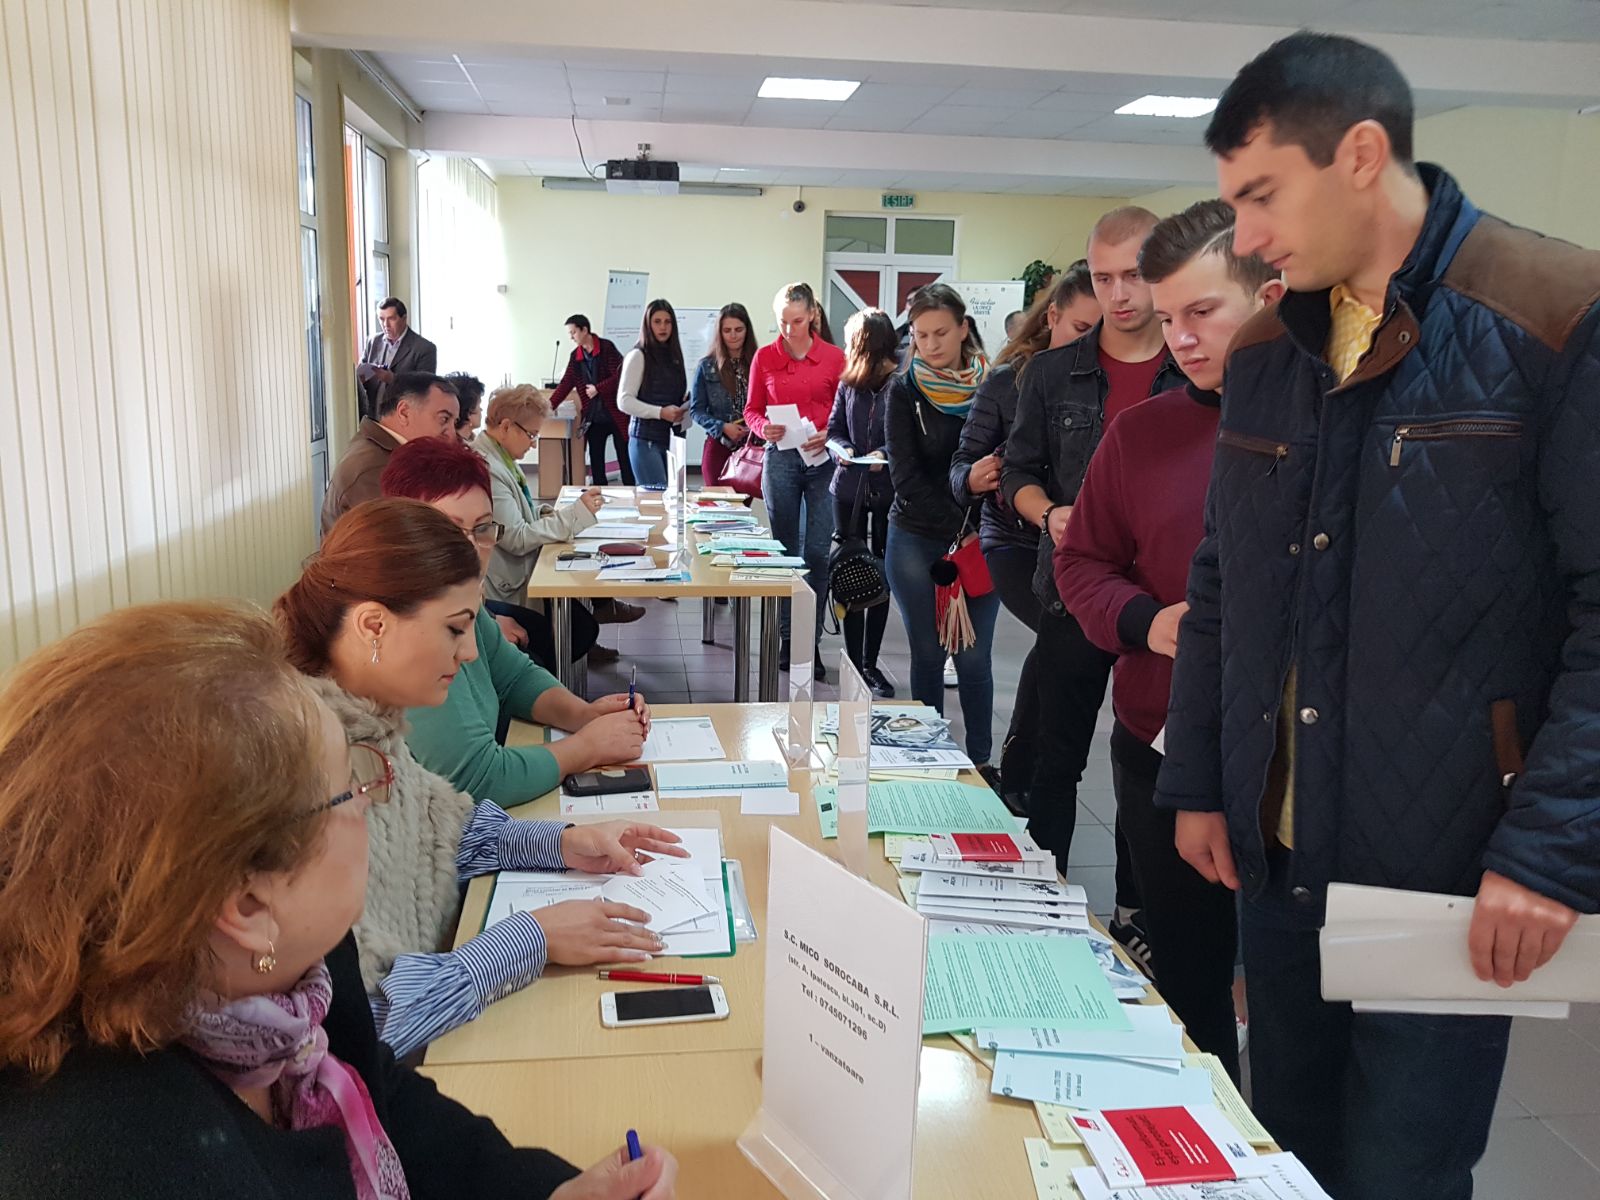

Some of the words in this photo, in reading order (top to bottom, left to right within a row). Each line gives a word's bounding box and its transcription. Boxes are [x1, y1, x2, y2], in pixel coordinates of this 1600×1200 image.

[784, 928, 798, 947] S.C.
[799, 940, 820, 962] MICO
[823, 957, 870, 999] SOROCABA
[874, 992, 900, 1020] S.R.L.
[801, 963, 809, 976] A.
[801, 982, 813, 999] Tel
[819, 996, 868, 1041] 0745071296
[808, 1032, 813, 1043] 1
[820, 1043, 865, 1084] vanzatoare
